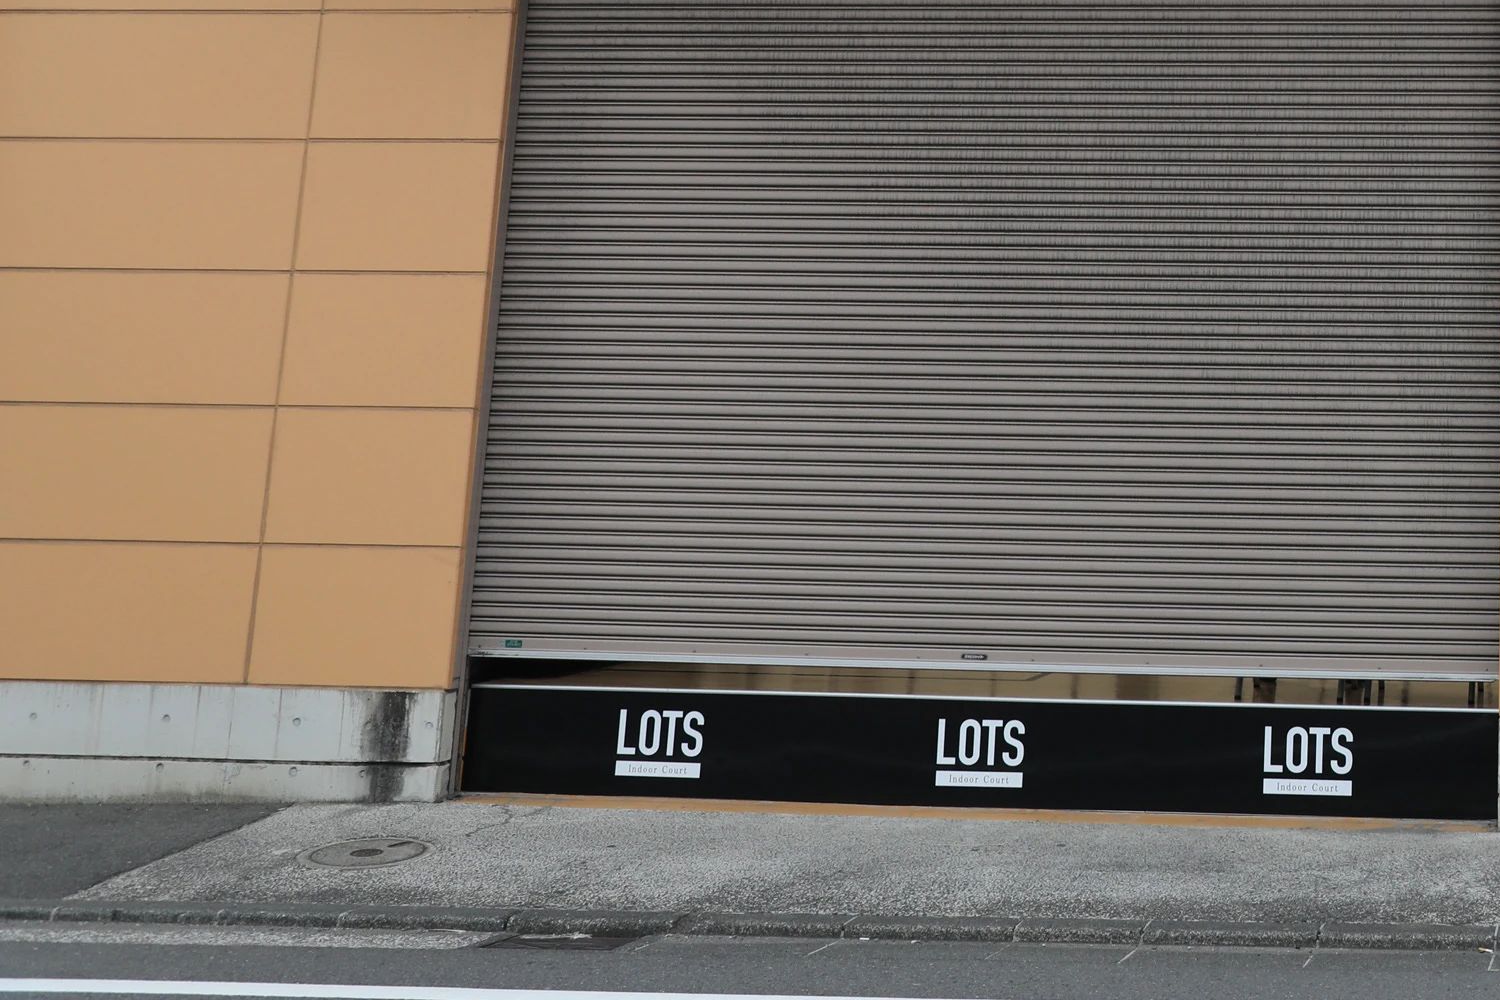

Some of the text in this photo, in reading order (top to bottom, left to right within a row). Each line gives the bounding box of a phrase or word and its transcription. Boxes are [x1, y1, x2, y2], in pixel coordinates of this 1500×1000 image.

[616, 708, 705, 758] LOTS
[936, 718, 1026, 767] LOTS
[1263, 725, 1354, 775] LOTS
[628, 763, 688, 775] Indoor Court
[948, 774, 1009, 785] Indoor Court
[1276, 782, 1339, 793] Indoor Court
